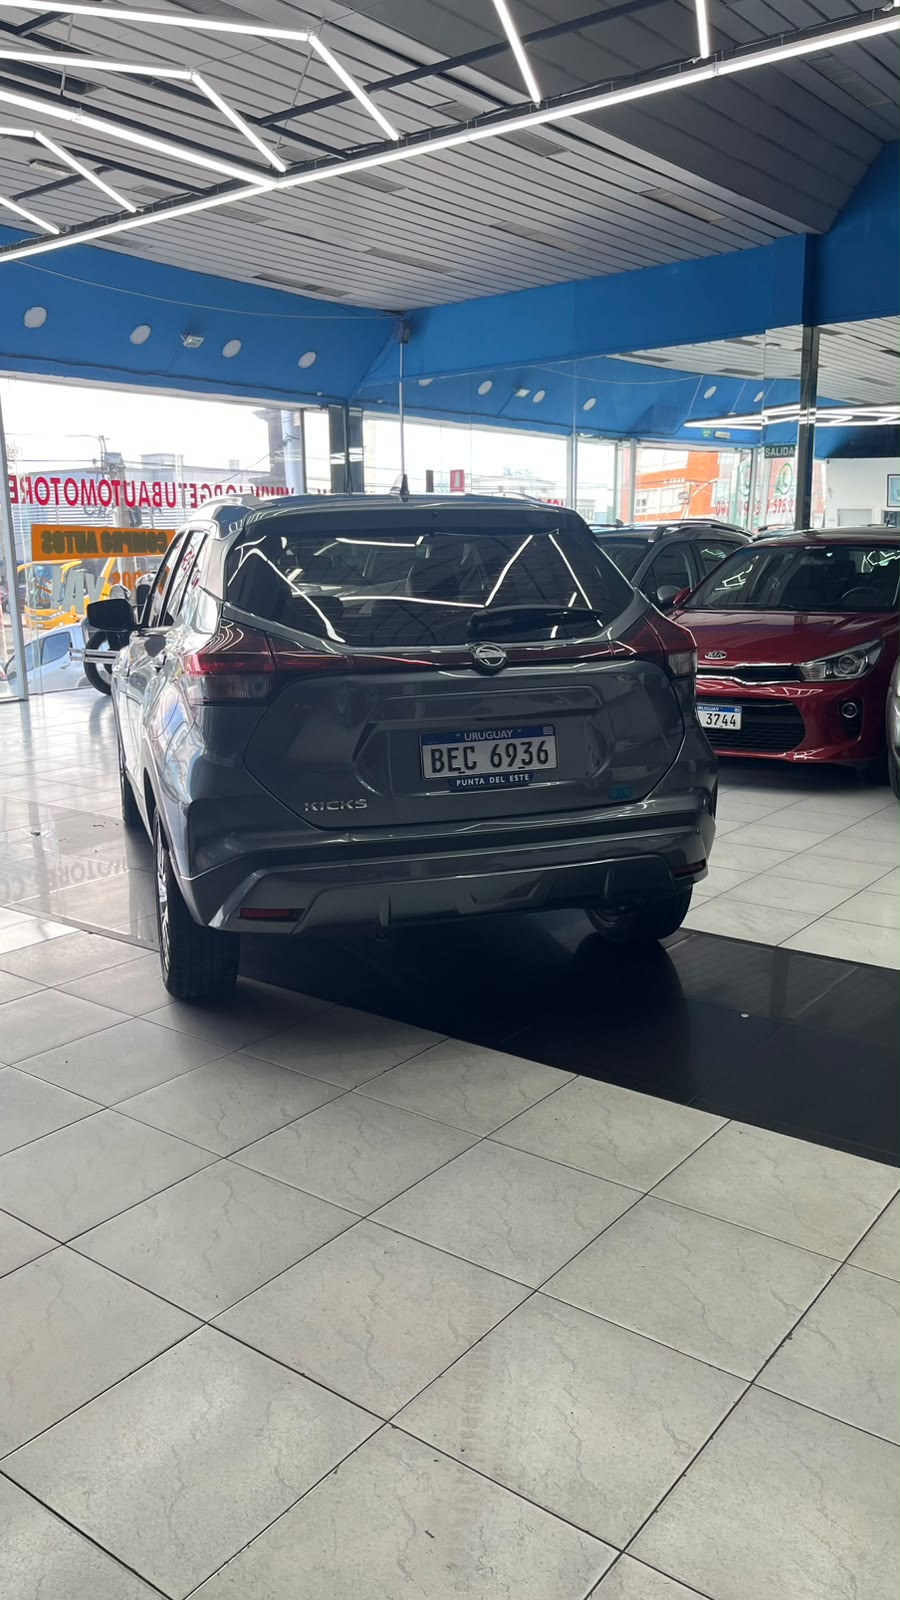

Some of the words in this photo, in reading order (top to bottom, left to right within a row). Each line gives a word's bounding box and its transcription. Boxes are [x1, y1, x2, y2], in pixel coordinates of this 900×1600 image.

[764, 446, 795, 457] SALIDA
[706, 712, 736, 727] 3744
[464, 729, 513, 741] URUGUAY
[430, 746, 477, 773] BEC
[490, 740, 549, 768] 6936
[456, 777, 486, 787] PUNTA
[489, 776, 505, 784] DEL
[509, 773, 530, 782] ESTE
[304, 798, 368, 812] KICKS
